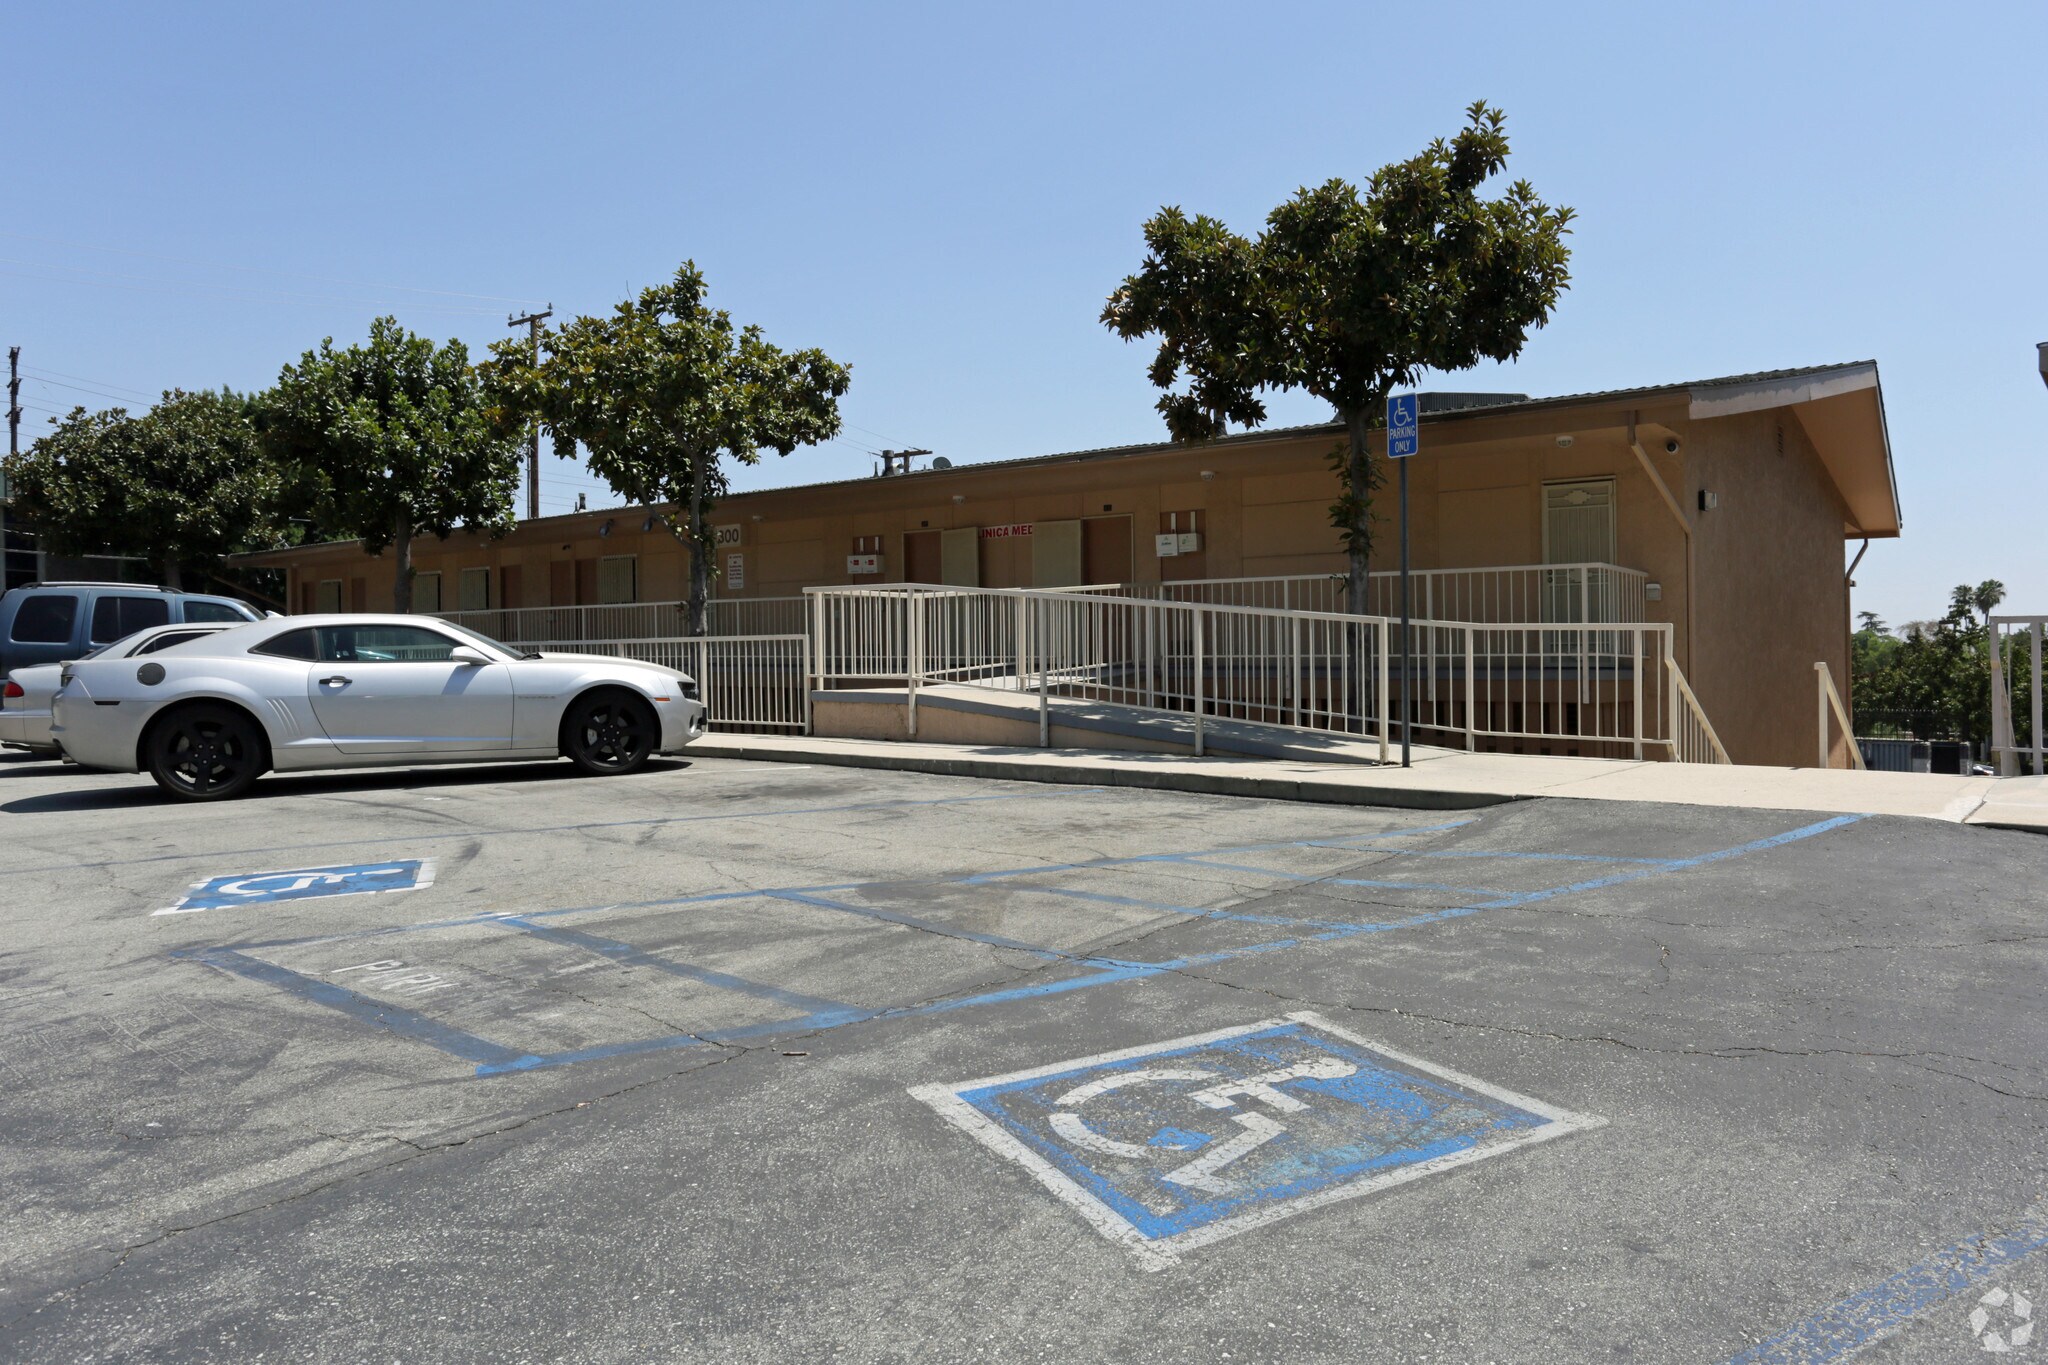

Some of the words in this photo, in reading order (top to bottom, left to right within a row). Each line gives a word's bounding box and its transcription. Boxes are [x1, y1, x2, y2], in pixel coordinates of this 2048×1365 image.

[1390, 425, 1415, 440] PARKING
[1395, 440, 1410, 453] ONLY
[718, 528, 739, 544] 300
